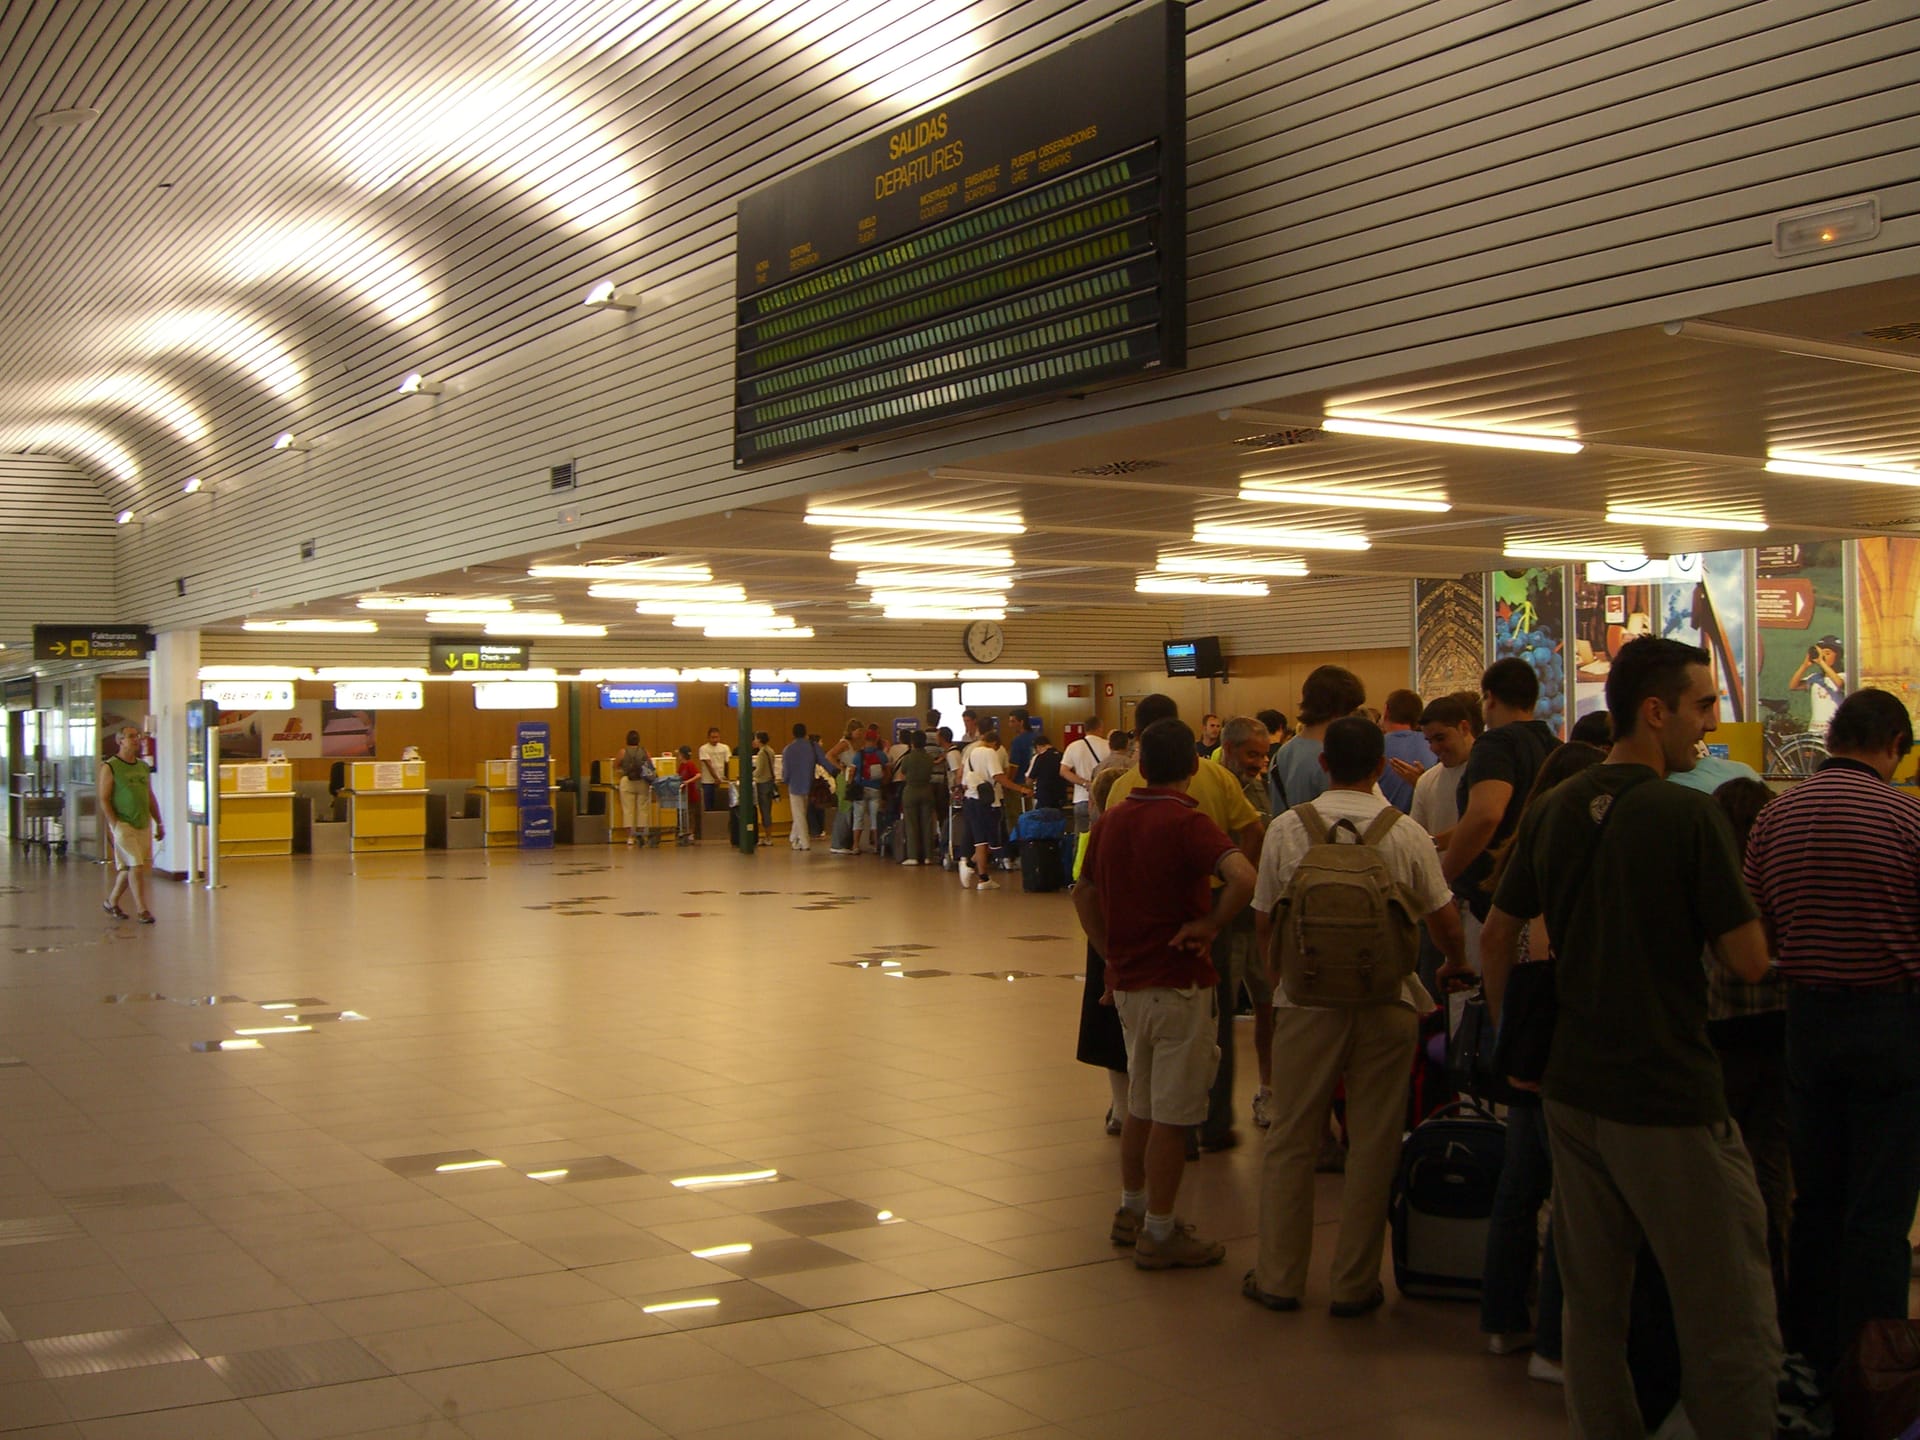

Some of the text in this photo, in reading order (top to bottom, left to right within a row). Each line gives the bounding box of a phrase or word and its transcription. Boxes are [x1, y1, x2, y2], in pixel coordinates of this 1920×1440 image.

[889, 112, 948, 160] SALIDAS
[1039, 124, 1097, 158] OBSERVACIONES
[875, 140, 964, 200] DEPARTURES
[272, 733, 313, 741] IBERIA
